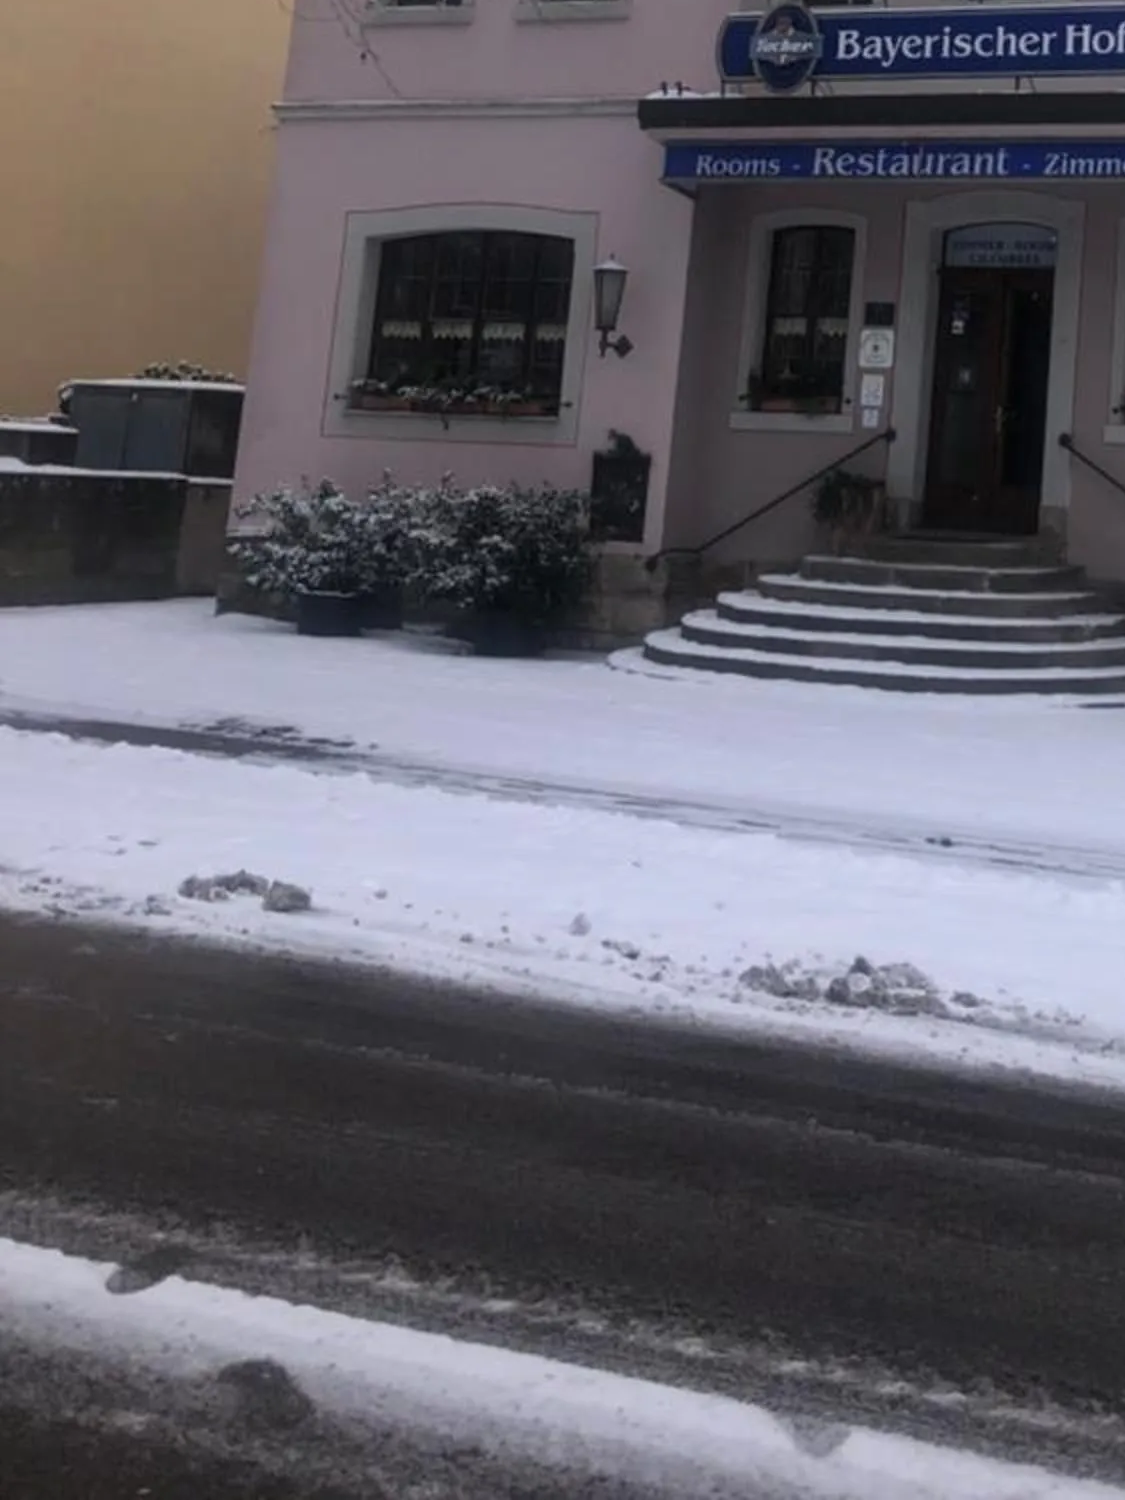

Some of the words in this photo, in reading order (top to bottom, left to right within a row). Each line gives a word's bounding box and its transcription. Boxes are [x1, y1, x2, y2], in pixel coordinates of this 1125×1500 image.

[836, 26, 1056, 67] Bayerischer
[696, 154, 780, 176] Rooms
[812, 148, 1008, 177] Restaurant
